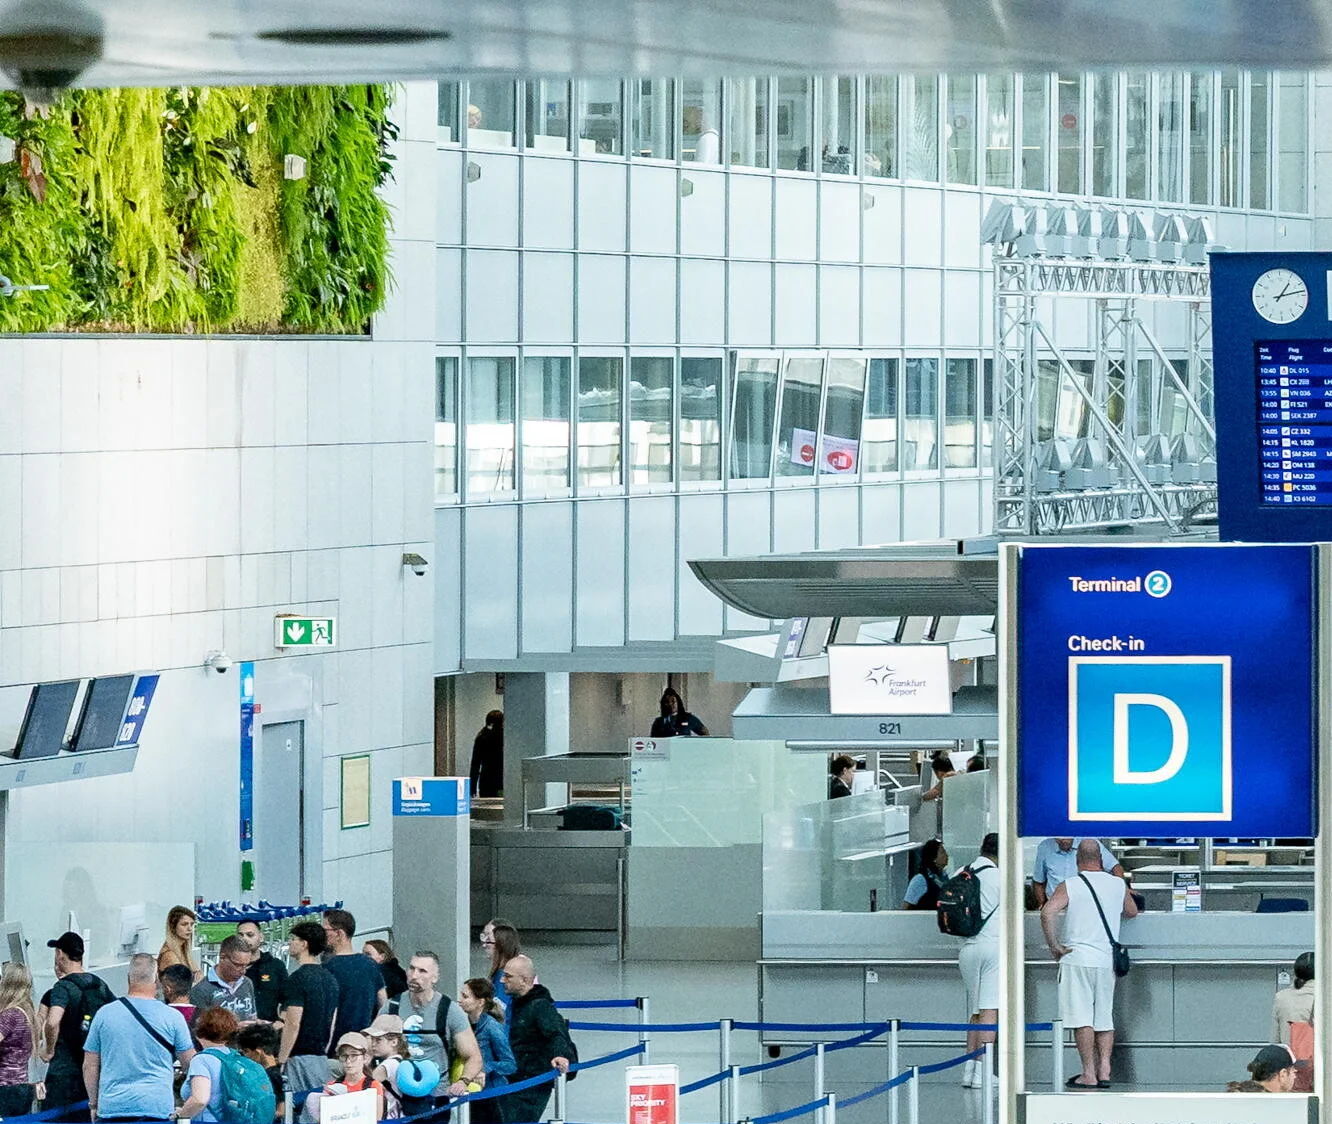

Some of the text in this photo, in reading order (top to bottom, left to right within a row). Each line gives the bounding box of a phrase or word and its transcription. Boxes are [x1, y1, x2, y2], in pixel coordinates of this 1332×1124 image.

[1069, 576, 1165, 593] Terminal 2
[1068, 635, 1145, 652] Check-in
[888, 678, 927, 689] Frankfurt
[888, 687, 918, 697] Airport
[879, 723, 902, 735] 821
[1113, 693, 1189, 784] D
